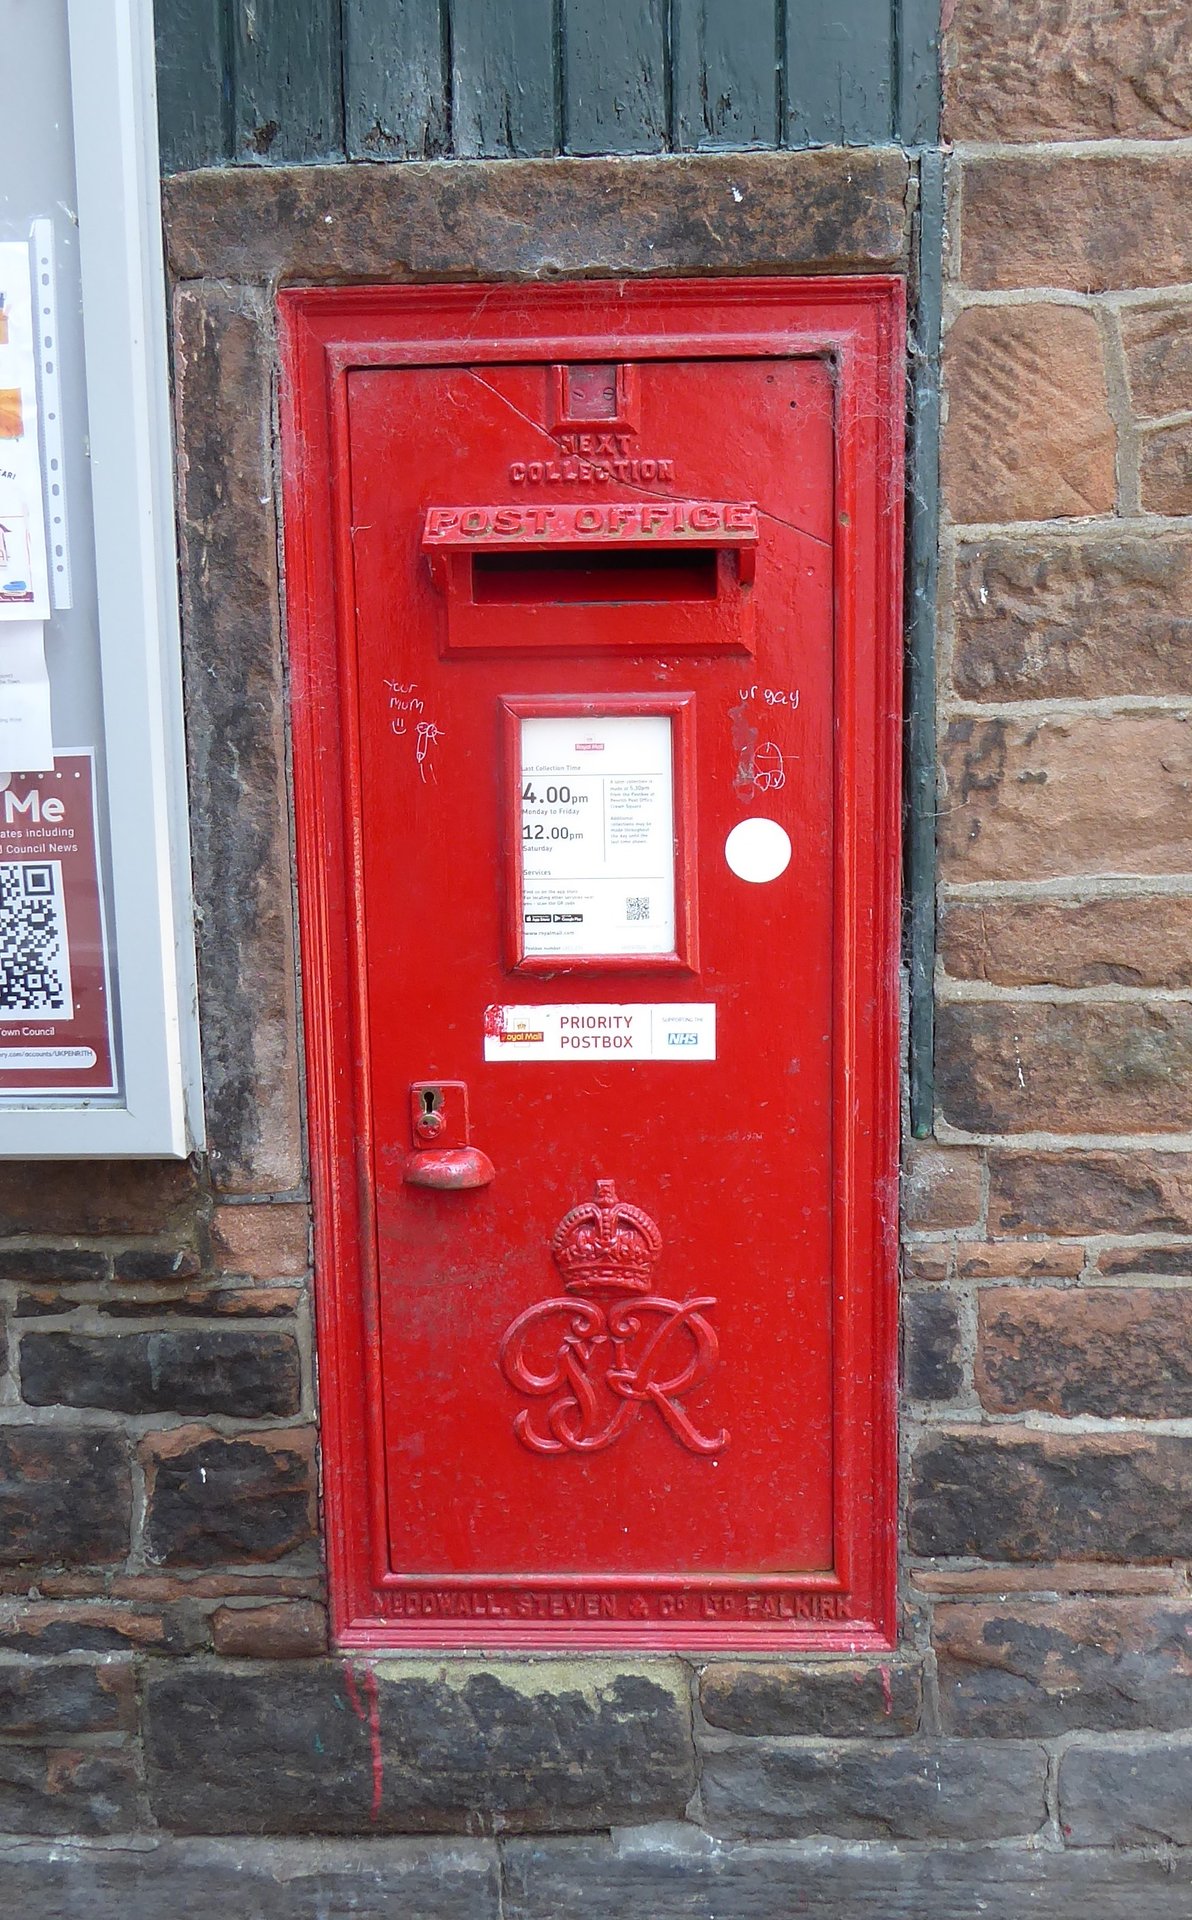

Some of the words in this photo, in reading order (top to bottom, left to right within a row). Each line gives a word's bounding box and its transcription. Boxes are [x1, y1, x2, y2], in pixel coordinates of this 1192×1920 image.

[560, 434, 634, 456] NEXT
[509, 459, 675, 483] COLLECTION
[427, 507, 556, 536] POST
[574, 503, 755, 534] OFFICE
[764, 689, 800, 709] gay
[5, 789, 65, 823] Me
[522, 808, 548, 816] Monday
[559, 808, 580, 816] Friday
[26, 827, 75, 839] including
[522, 824, 584, 841] 12.00pm
[6, 843, 46, 854] Council
[49, 843, 78, 852] News
[522, 845, 553, 853] Saturday
[560, 1016, 633, 1029] PRIORITY
[22, 1026, 55, 1036] Council
[524, 1032, 543, 1040] Mail
[561, 1035, 633, 1049] POSTBOX
[669, 1033, 697, 1044] NHS
[516, 1593, 617, 1616] STEVEN
[745, 1593, 853, 1618] FALKIRK
